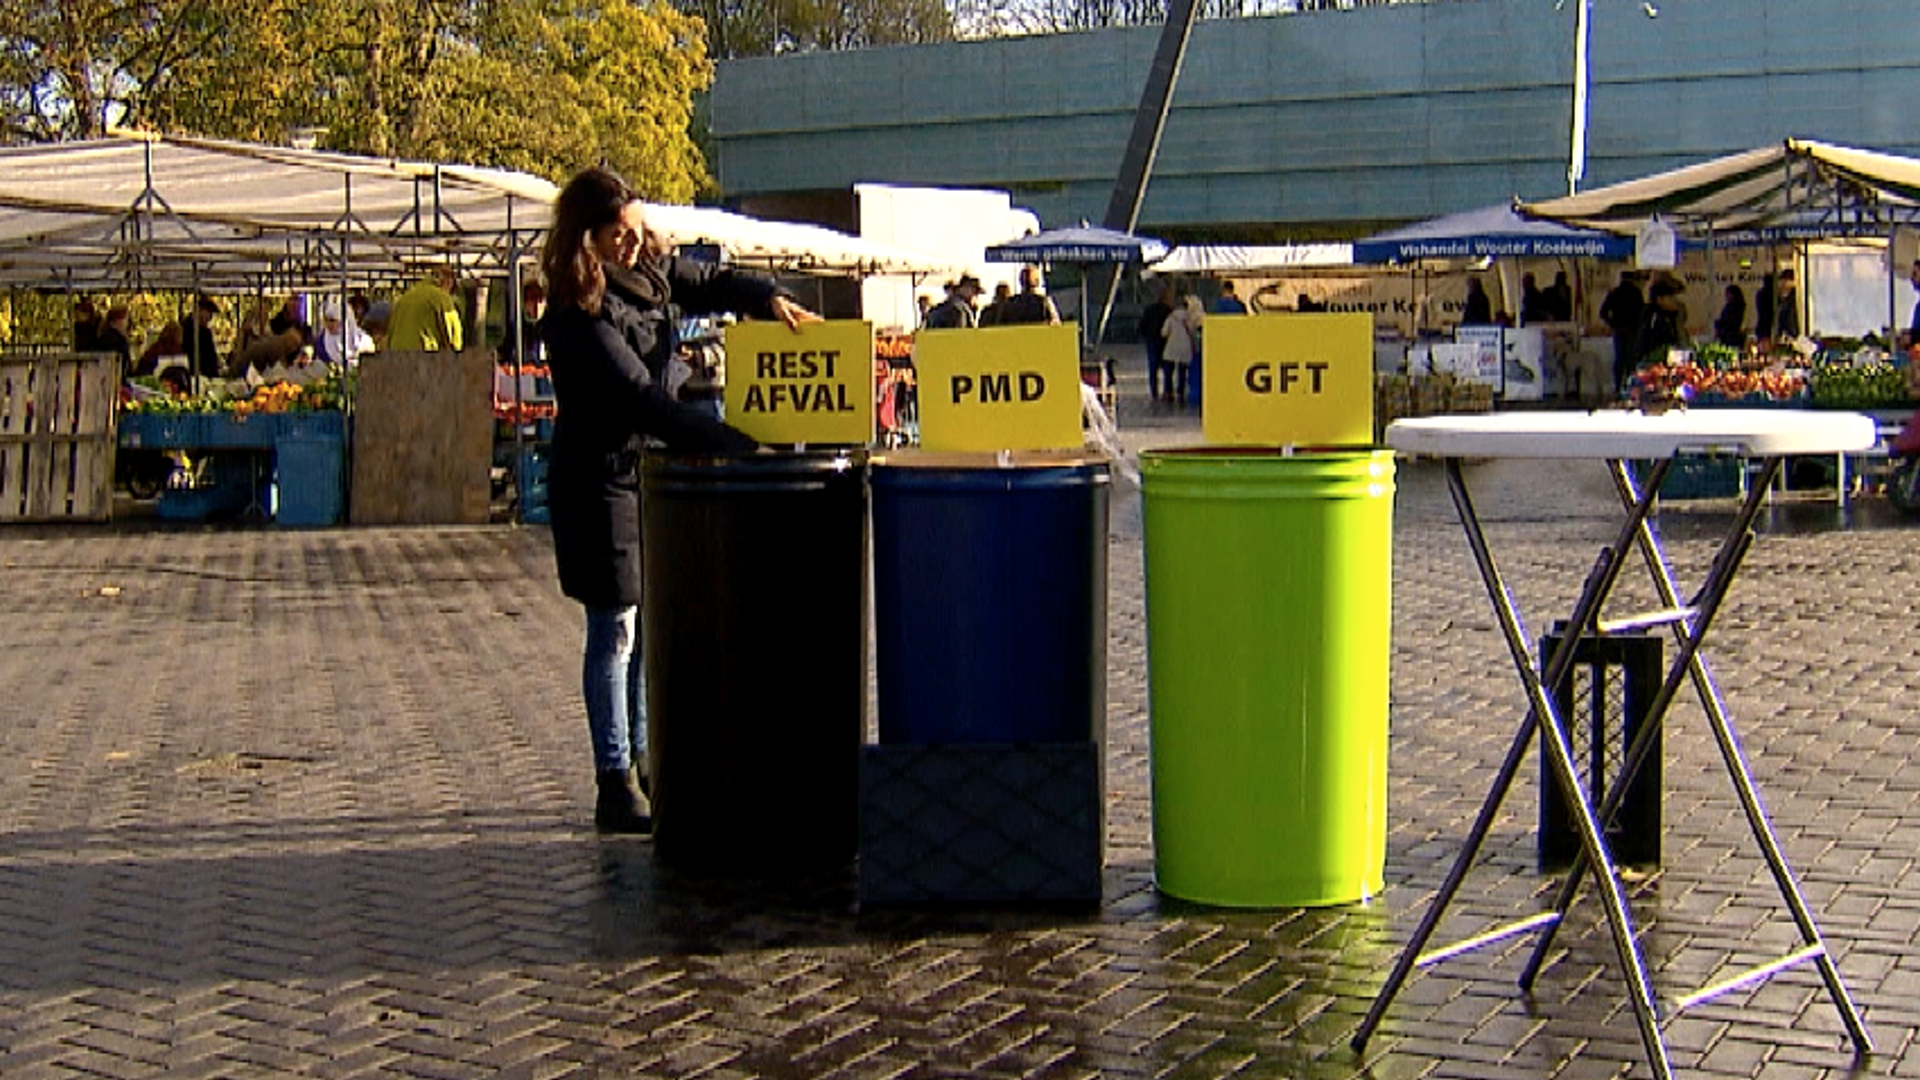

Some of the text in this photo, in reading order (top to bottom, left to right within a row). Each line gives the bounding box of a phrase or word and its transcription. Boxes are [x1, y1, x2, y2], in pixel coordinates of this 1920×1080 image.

[1475, 240, 1528, 255] Wouter
[1533, 240, 1605, 257] Koelewijn
[757, 351, 841, 379] REST
[1245, 362, 1328, 394] GFT
[743, 384, 854, 412] AFVAL
[952, 373, 1045, 403] PMD
